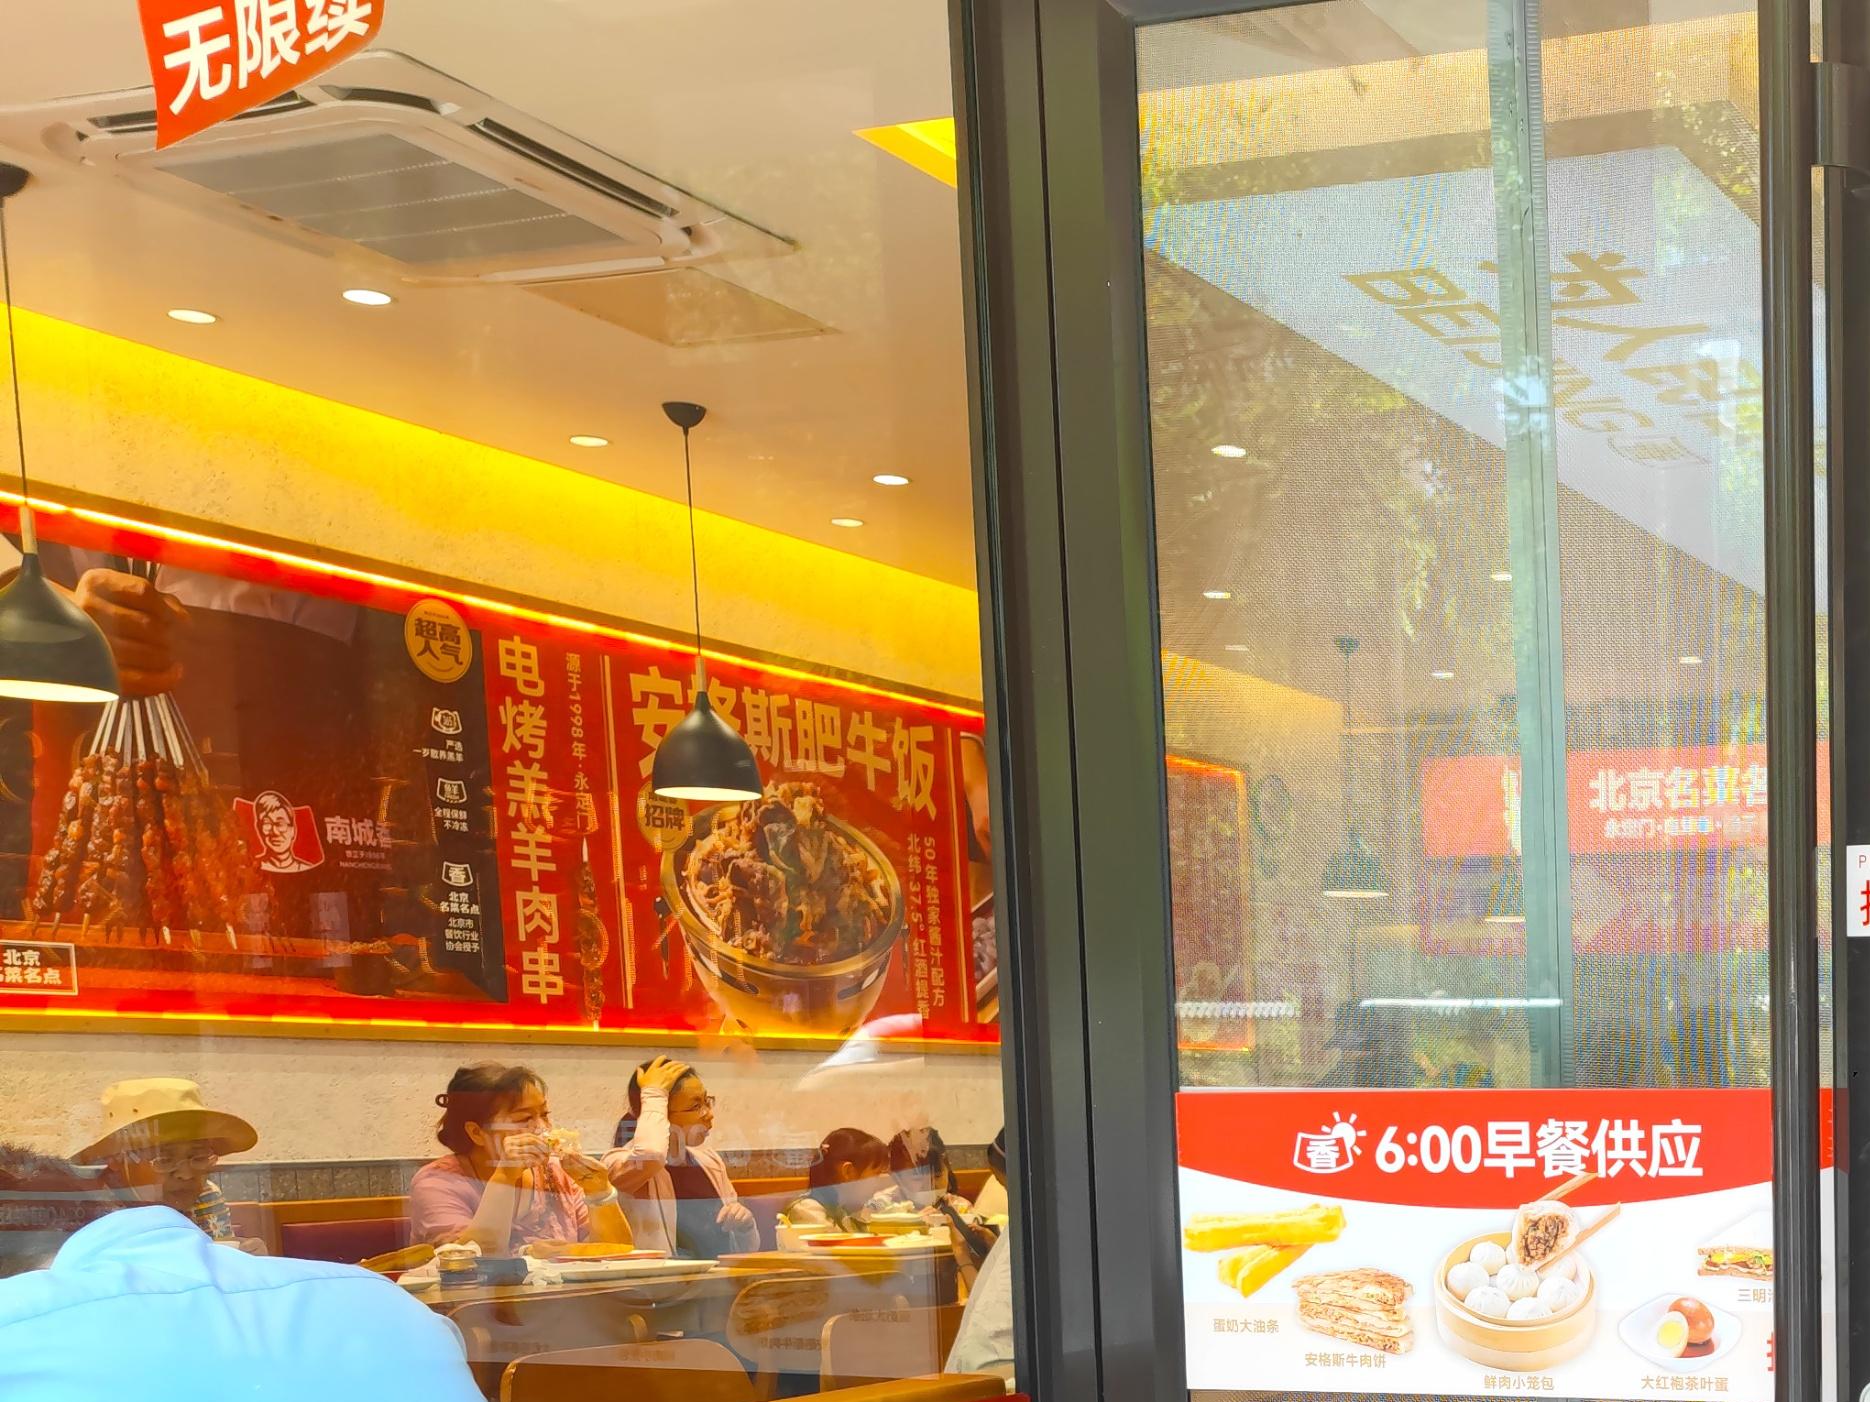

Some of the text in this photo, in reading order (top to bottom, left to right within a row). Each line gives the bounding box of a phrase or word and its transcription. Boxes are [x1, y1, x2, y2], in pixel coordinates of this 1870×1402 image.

[162, 0, 372, 115] 无限续
[415, 617, 461, 645] 超高
[417, 640, 463, 666] 人气
[498, 635, 565, 1004] 电烤羔羊肉串
[645, 803, 685, 831] 招牌
[3, 948, 41, 966] 北京
[0, 967, 63, 985] 菜名点
[1375, 1118, 1704, 1179] 6:00早餐供应
[1737, 1288, 1776, 1304] 三明
[1213, 1318, 1280, 1335] 蛋奶大油条
[1304, 1352, 1388, 1369] 安格斯牛肉饼
[1484, 1374, 1556, 1391] 鲜肉小笼包
[1641, 1375, 1729, 1393] 大红袍茶叶蛋
